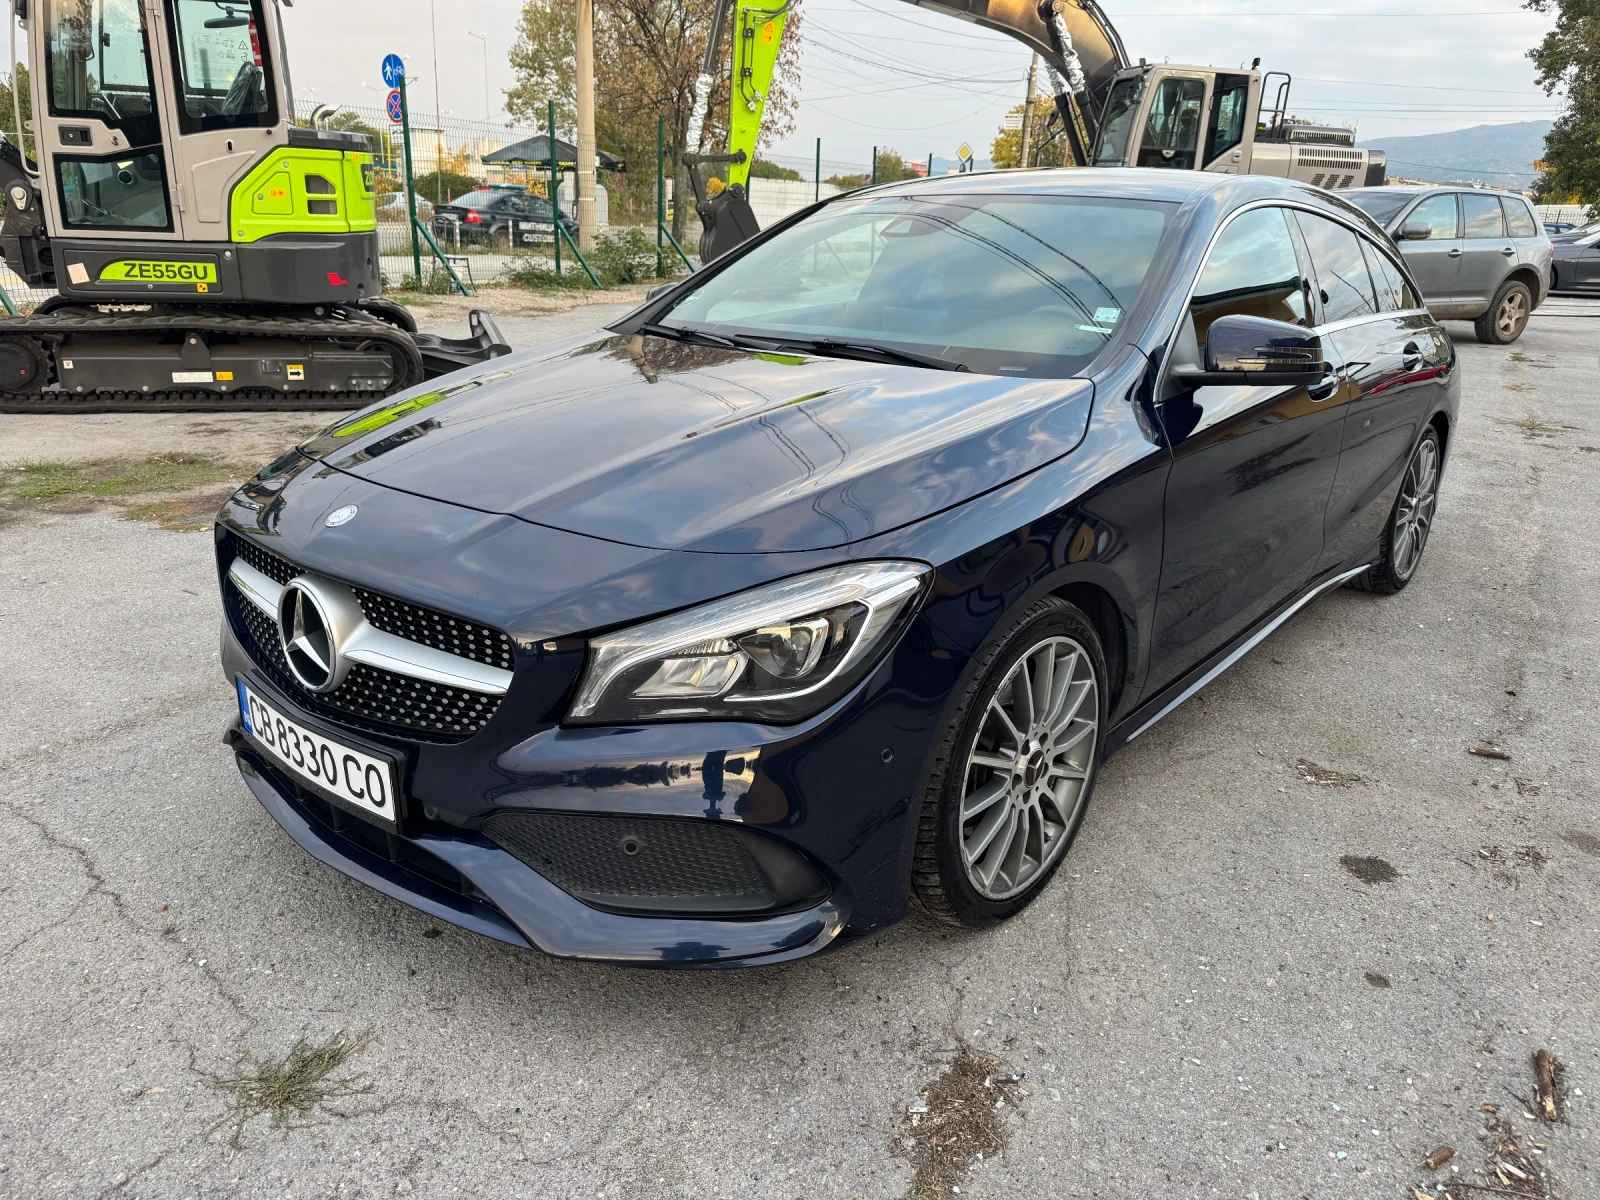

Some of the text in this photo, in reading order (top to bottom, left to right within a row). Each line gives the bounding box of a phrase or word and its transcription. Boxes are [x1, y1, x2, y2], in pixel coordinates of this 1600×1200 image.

[518, 221, 555, 232] МИТНИЦ
[522, 233, 555, 243] CUSTOM
[123, 262, 208, 280] ZE55GU
[249, 695, 386, 808] CB 8330 CO
